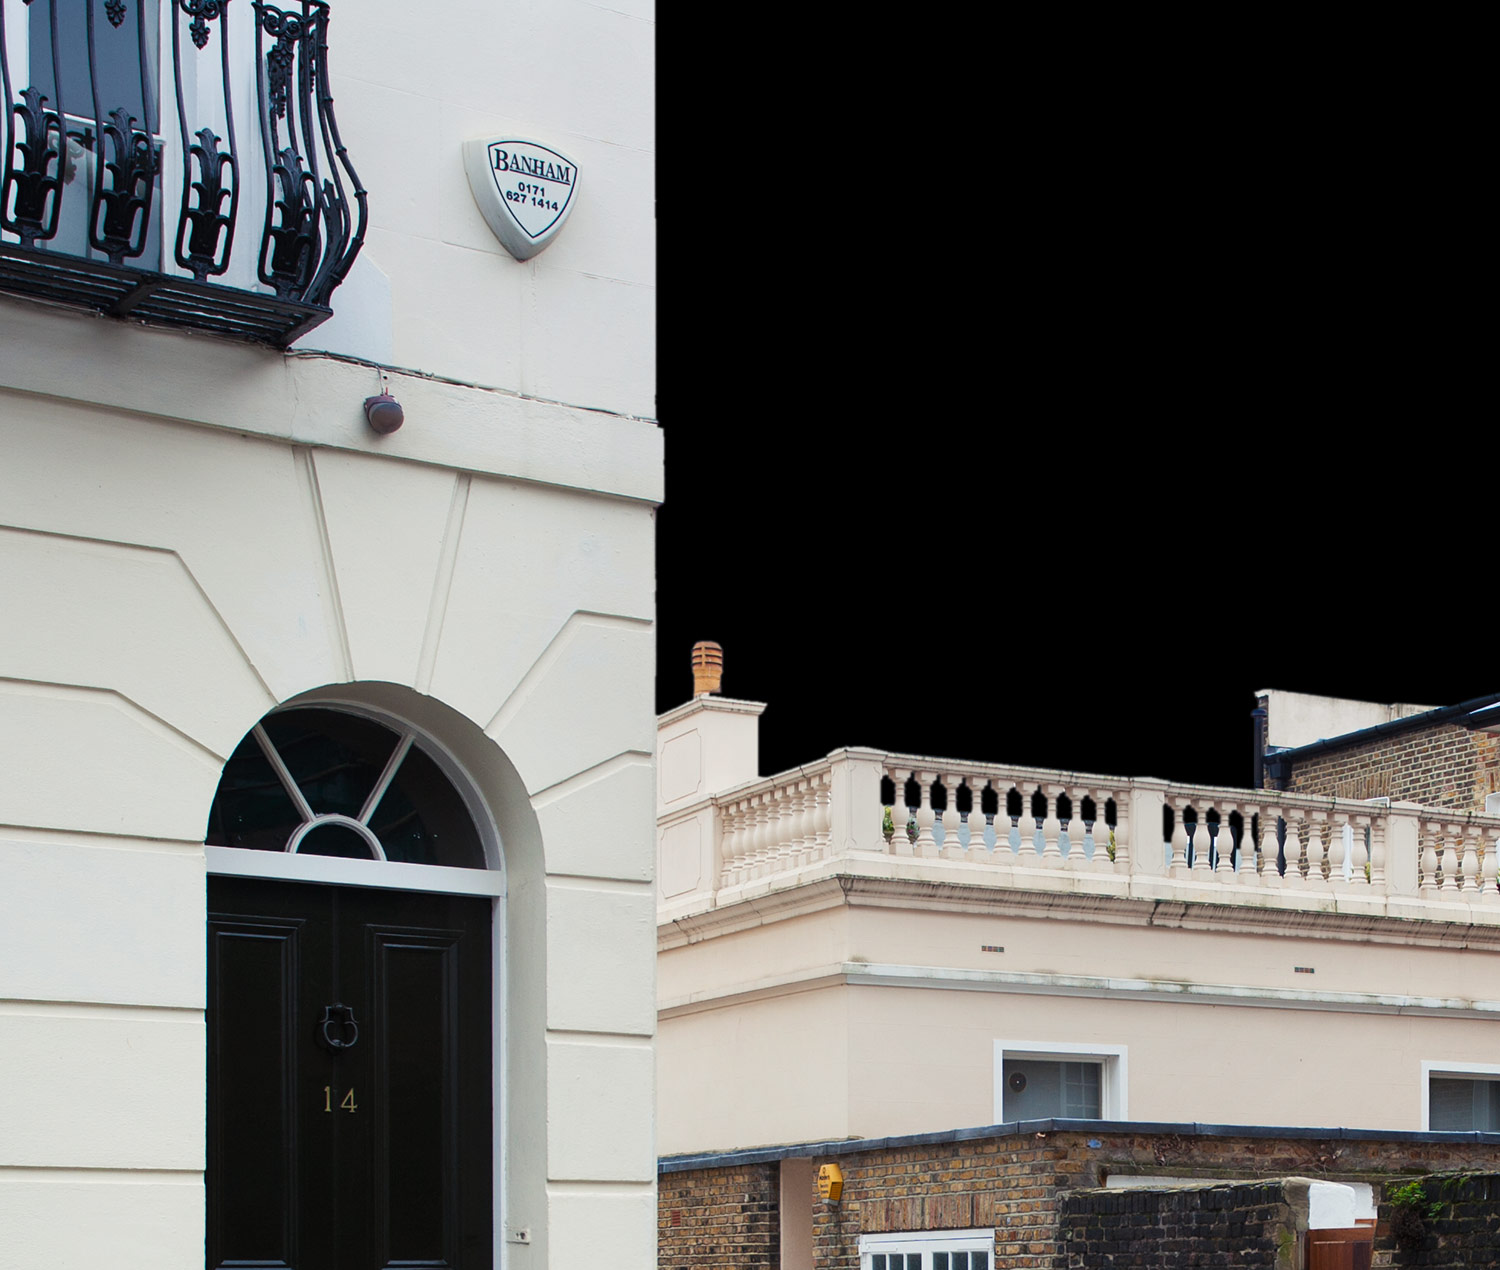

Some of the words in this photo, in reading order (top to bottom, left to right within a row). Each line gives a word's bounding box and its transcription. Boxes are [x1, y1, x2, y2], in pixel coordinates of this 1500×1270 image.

[494, 148, 571, 183] BANHAM
[506, 190, 527, 204] 627
[531, 197, 559, 211] 1414
[518, 182, 545, 197] 0171
[324, 1086, 358, 1113] 14
